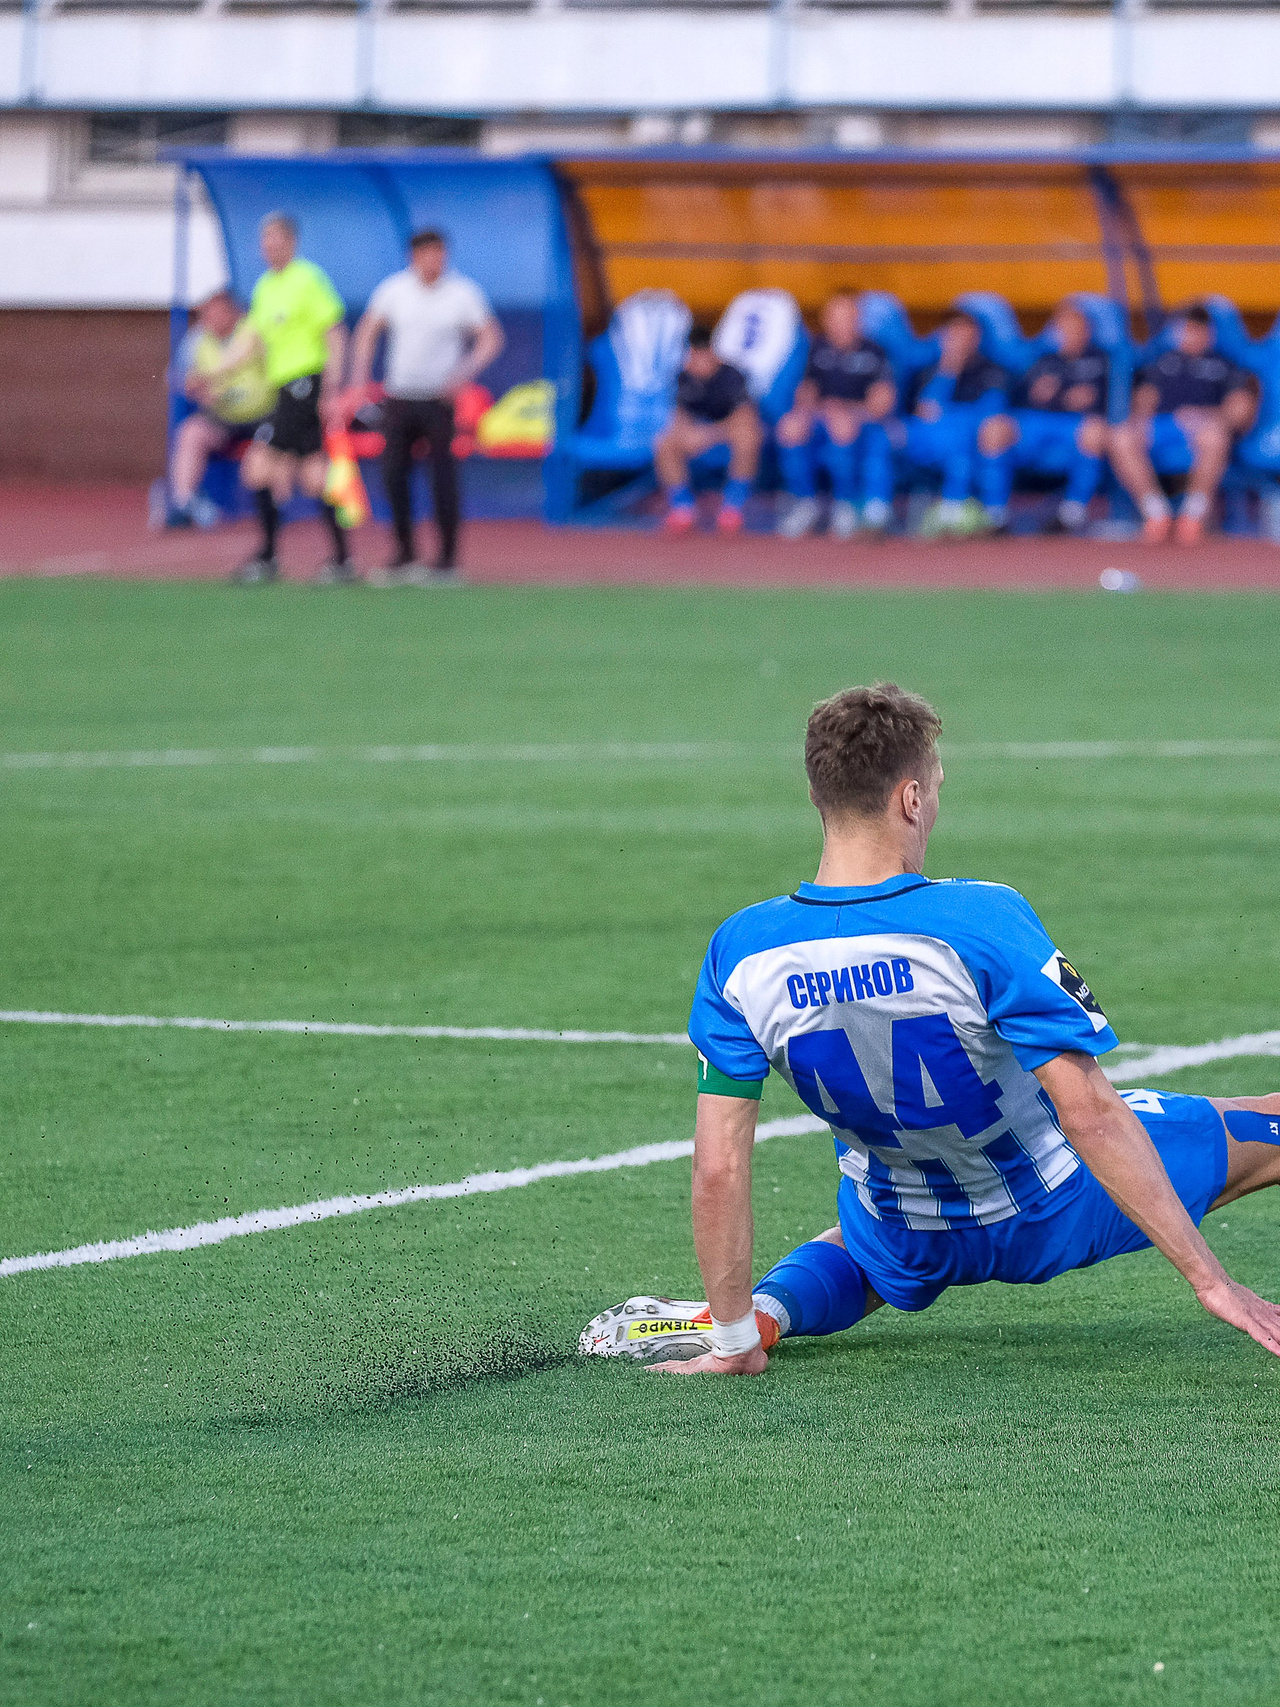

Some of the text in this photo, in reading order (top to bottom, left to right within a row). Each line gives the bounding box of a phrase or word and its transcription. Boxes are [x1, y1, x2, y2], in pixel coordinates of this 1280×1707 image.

[787, 957, 915, 1010] СЕРИКОВ
[787, 1012, 1005, 1150] 44
[637, 1321, 698, 1334] TIEMPO
